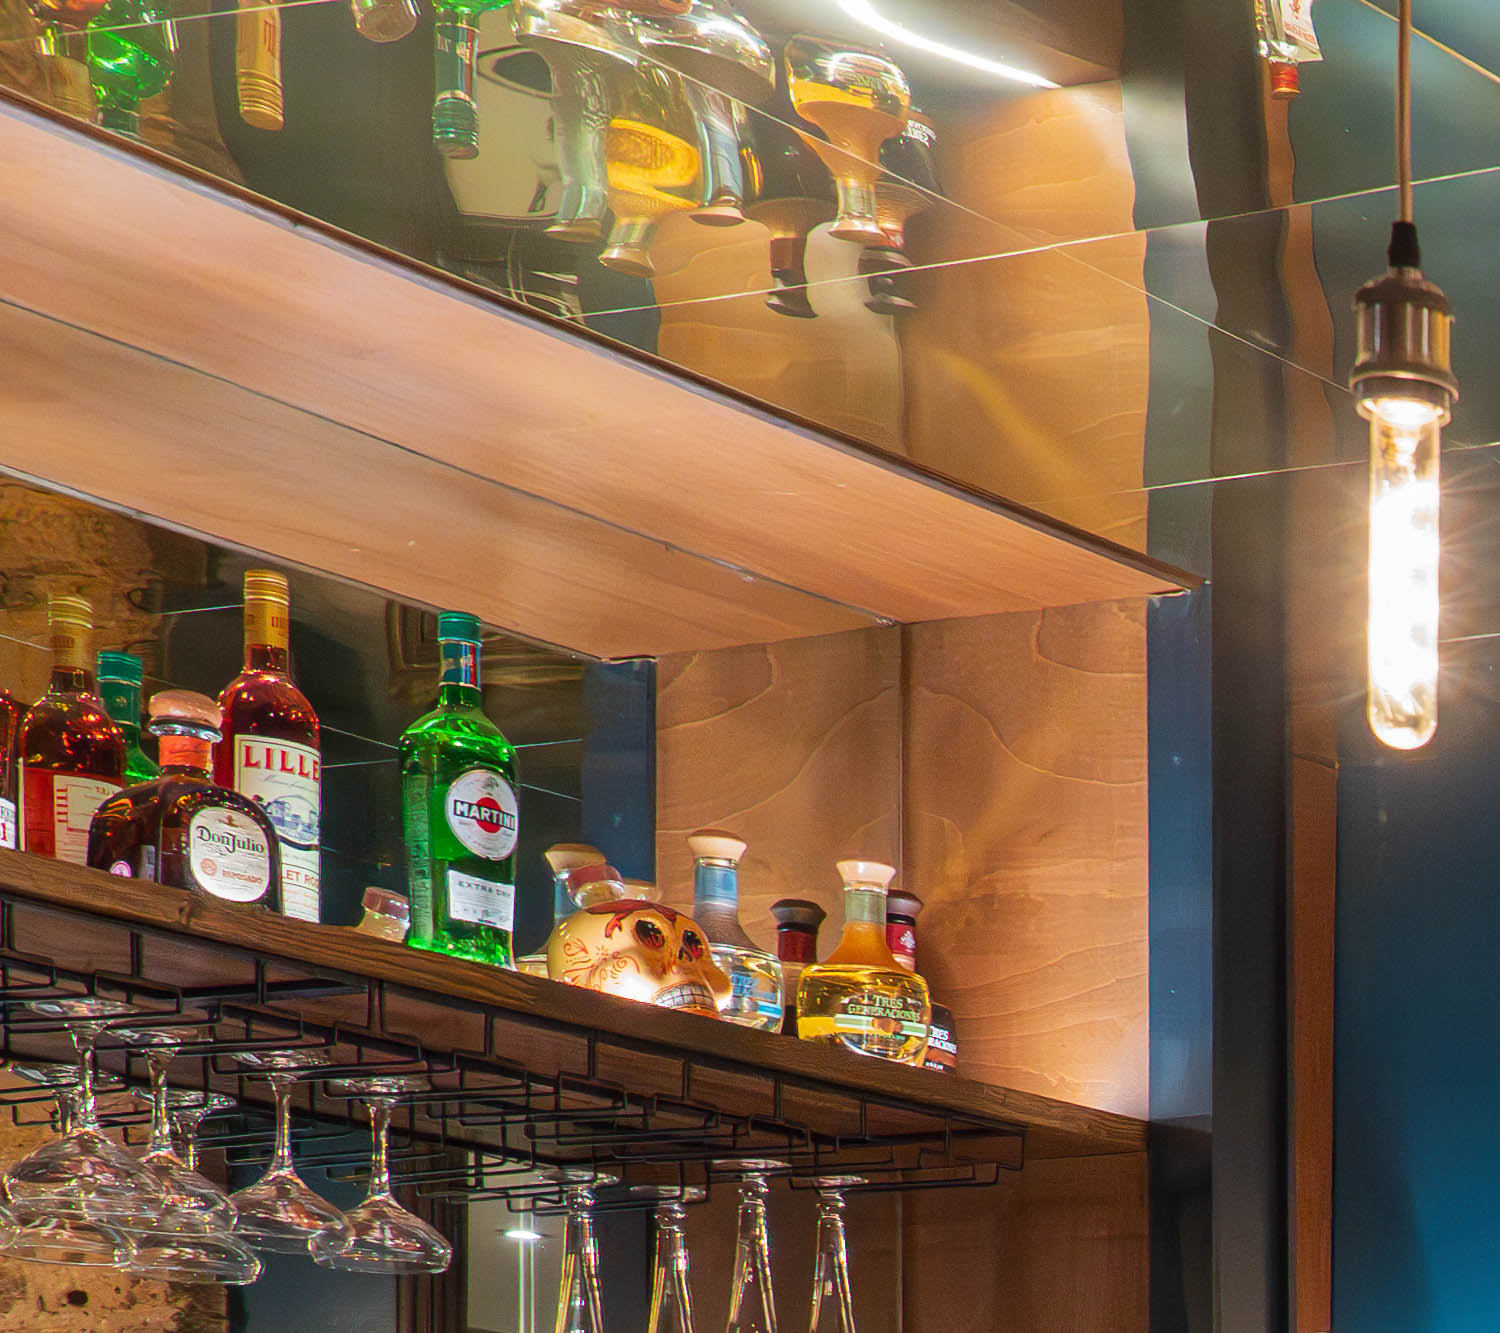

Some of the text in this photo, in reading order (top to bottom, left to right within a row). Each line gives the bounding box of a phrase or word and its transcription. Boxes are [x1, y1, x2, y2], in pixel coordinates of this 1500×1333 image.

[454, 799, 516, 831] MARTINI
[458, 880, 492, 894] EXTRA
[873, 994, 904, 1010] TRES
